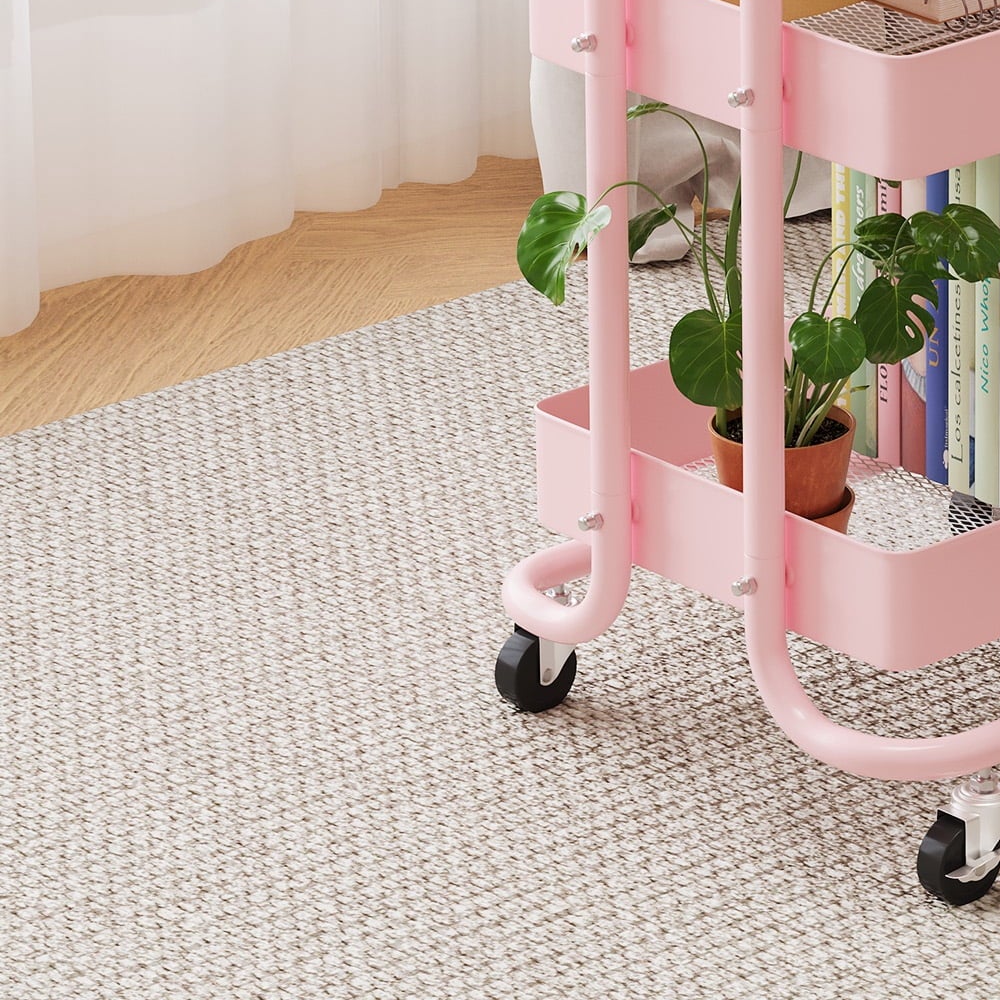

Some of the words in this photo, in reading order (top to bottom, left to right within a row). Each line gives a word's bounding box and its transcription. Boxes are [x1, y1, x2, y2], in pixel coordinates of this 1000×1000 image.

[951, 283, 961, 406] calcetines
[980, 344, 989, 394] Nico
[951, 414, 963, 463] Los
